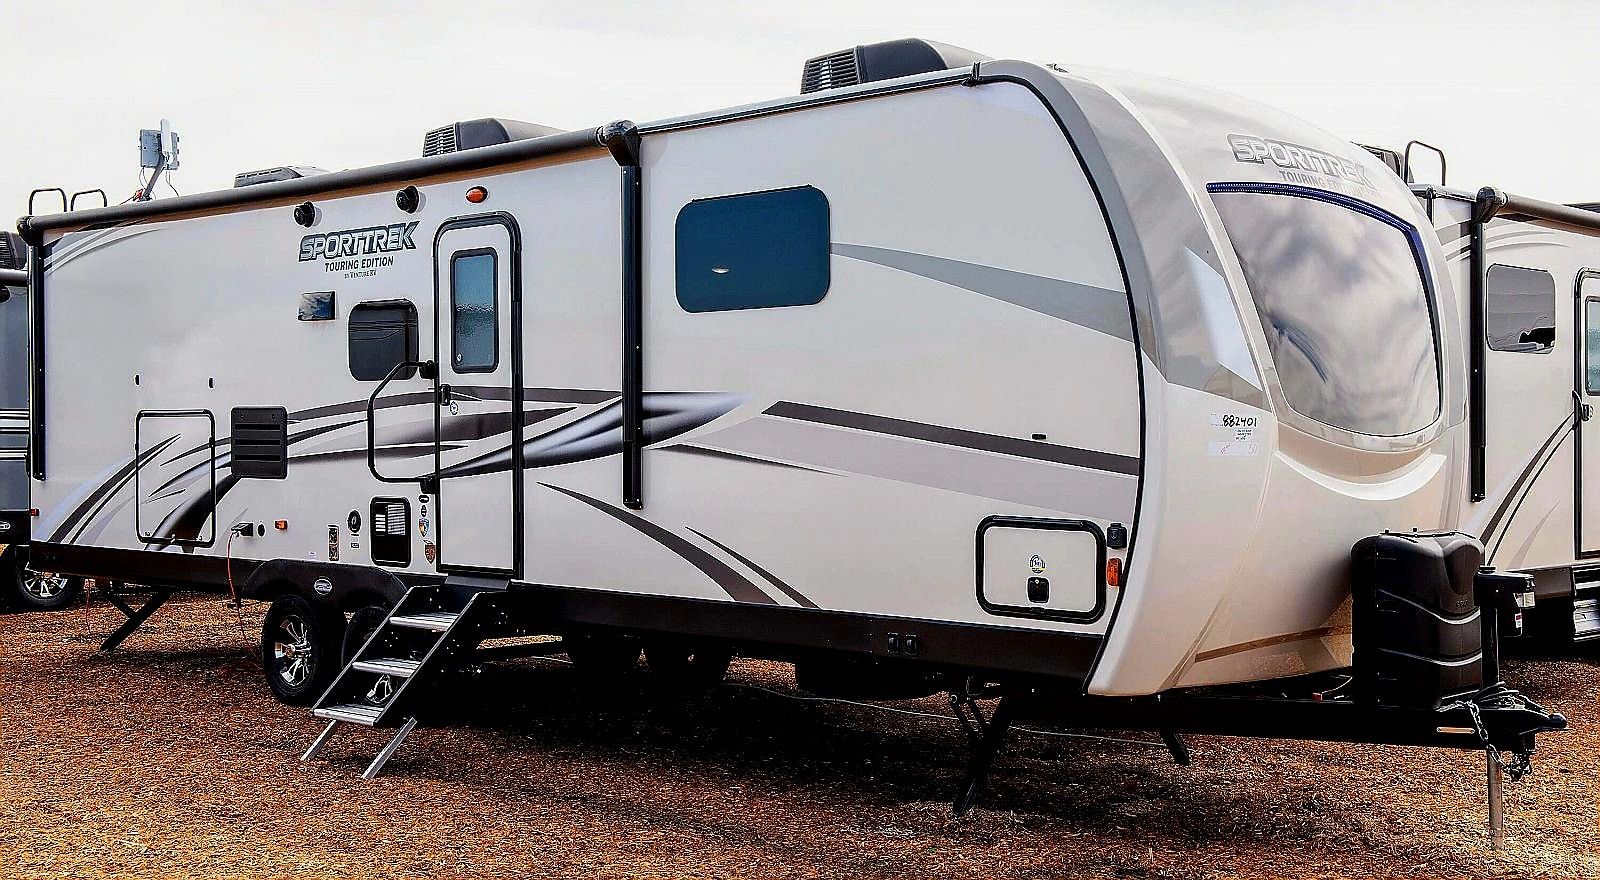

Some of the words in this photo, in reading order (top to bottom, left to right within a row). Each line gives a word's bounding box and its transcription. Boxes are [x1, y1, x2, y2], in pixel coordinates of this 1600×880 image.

[1227, 134, 1377, 191] SPORTTREK
[1279, 170, 1326, 187] TOURING
[299, 220, 420, 262] SPORTTREK
[325, 261, 359, 272] TOURING
[361, 256, 394, 269] EDITION
[1223, 414, 1257, 428] 882401
